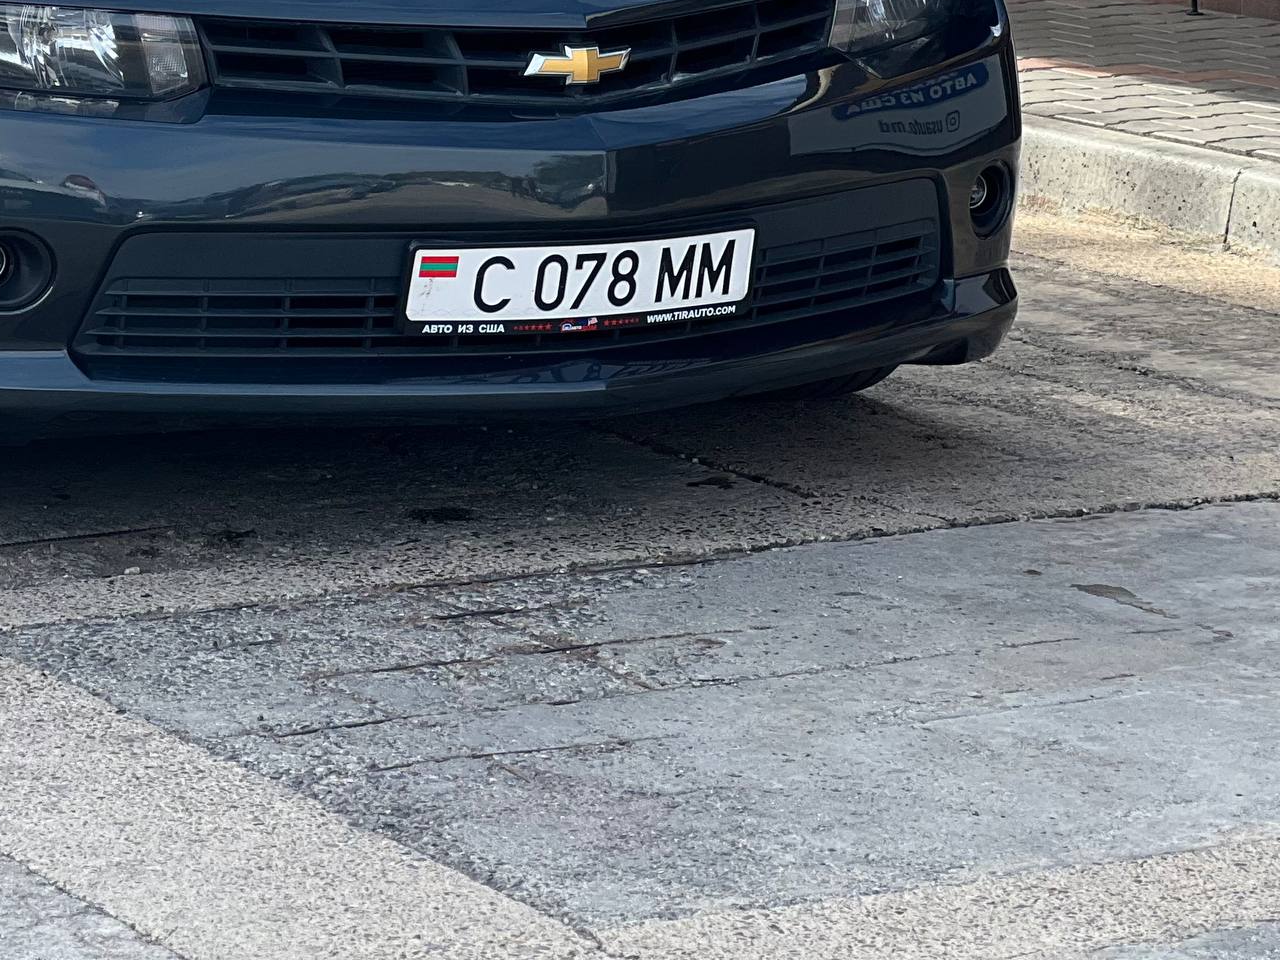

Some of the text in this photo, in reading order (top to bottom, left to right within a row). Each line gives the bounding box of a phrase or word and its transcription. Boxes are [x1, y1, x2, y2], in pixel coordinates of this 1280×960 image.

[473, 239, 736, 313] C 078 MM
[646, 304, 736, 324] WWW.TIRAUTO.COM
[422, 324, 505, 334] АВТО ИЗ США
